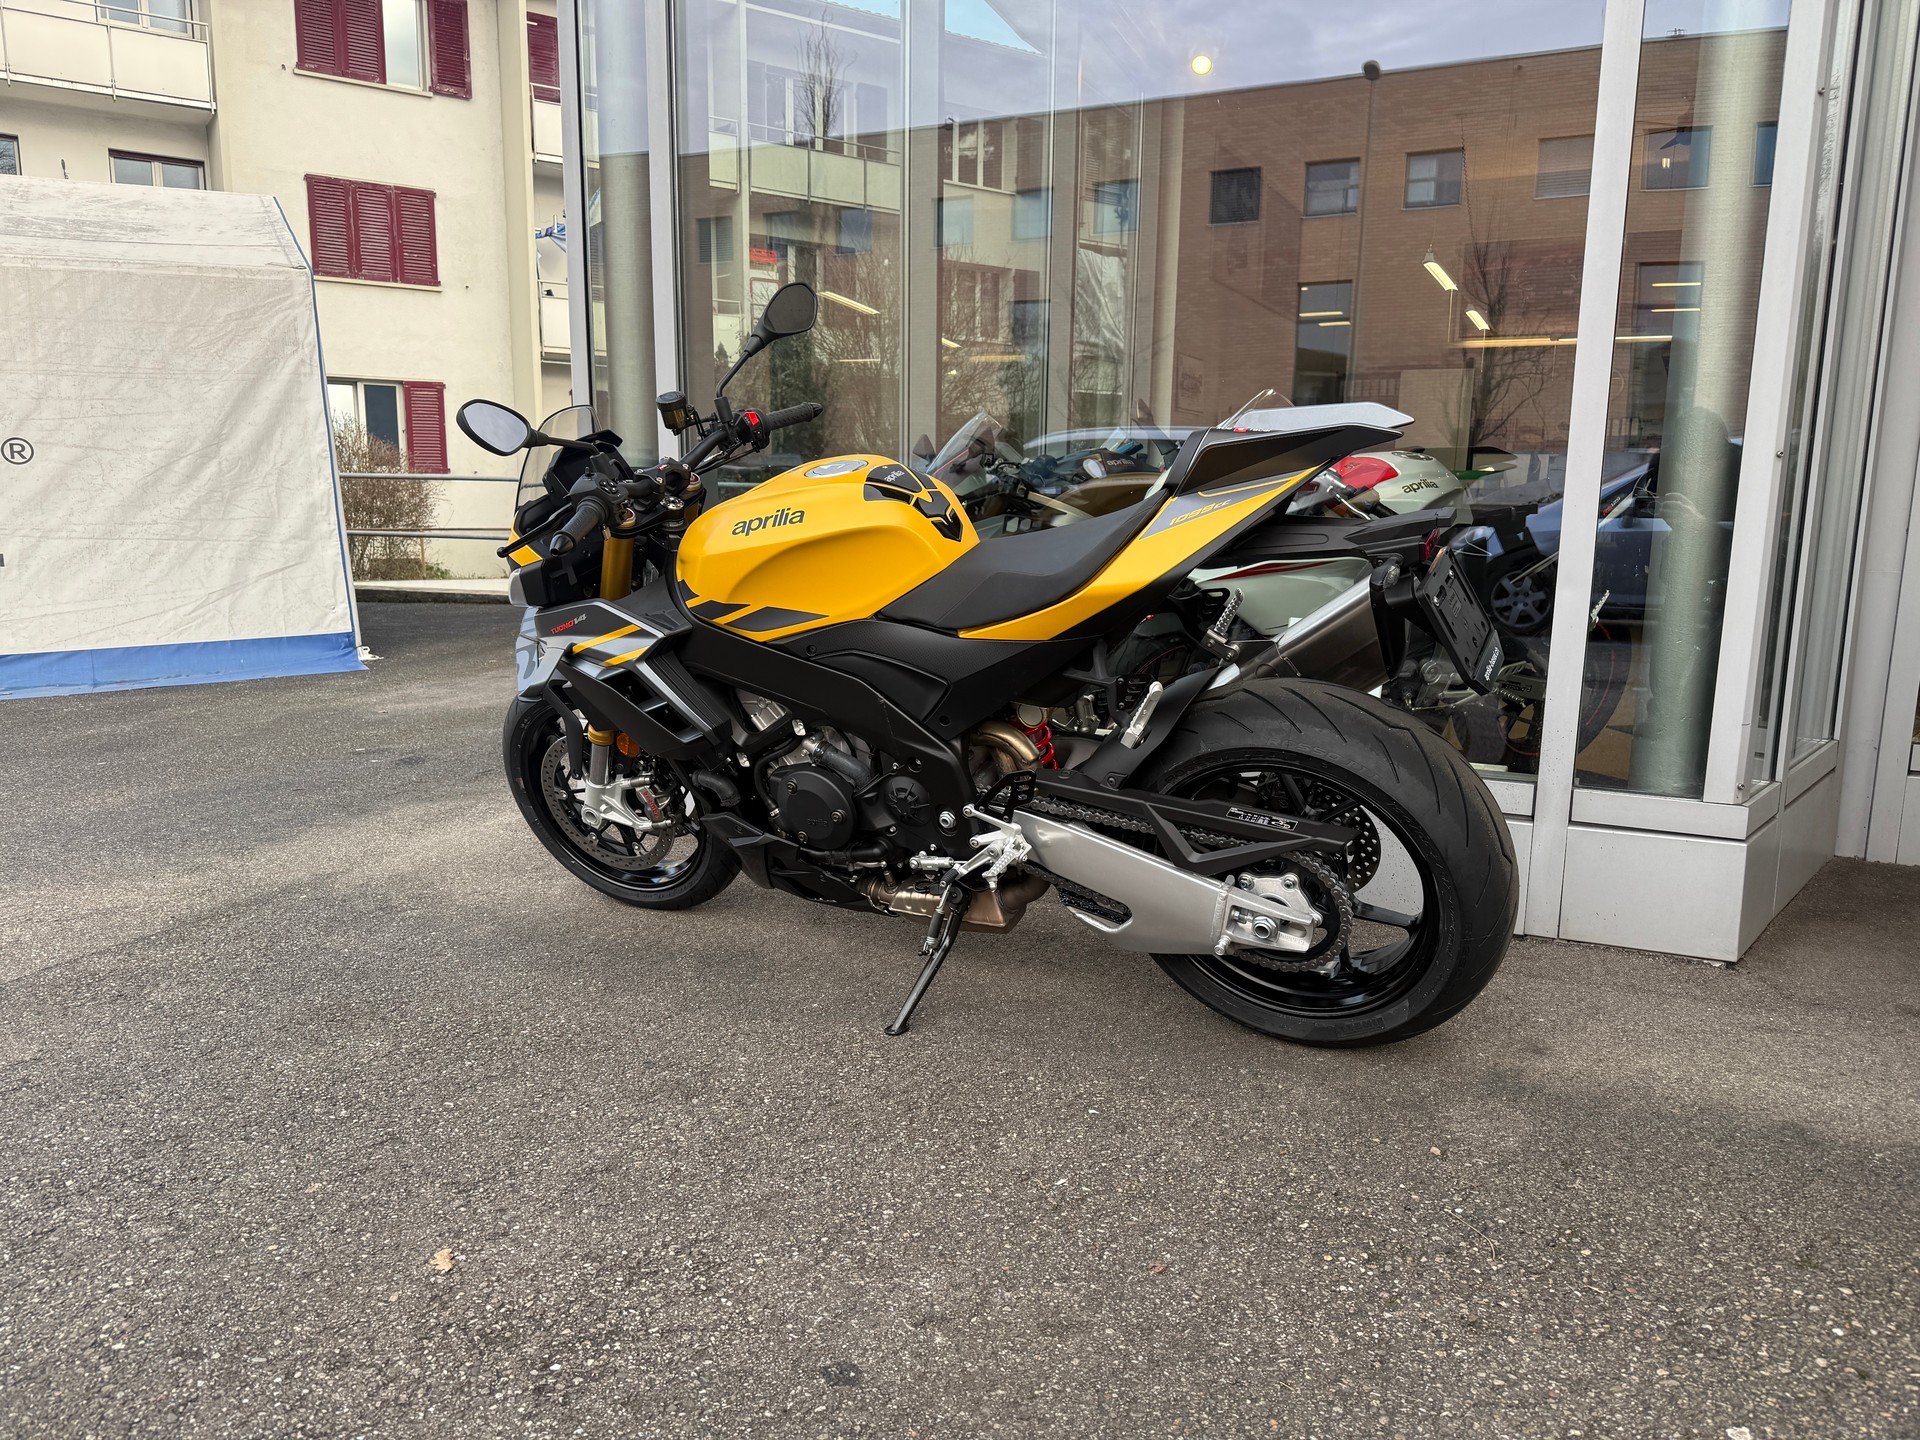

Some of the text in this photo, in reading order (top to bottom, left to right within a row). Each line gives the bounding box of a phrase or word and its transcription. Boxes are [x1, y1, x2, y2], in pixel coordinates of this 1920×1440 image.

[884, 470, 905, 483] aprilia
[1401, 478, 1440, 494] aprilia
[731, 507, 806, 537] aprilia
